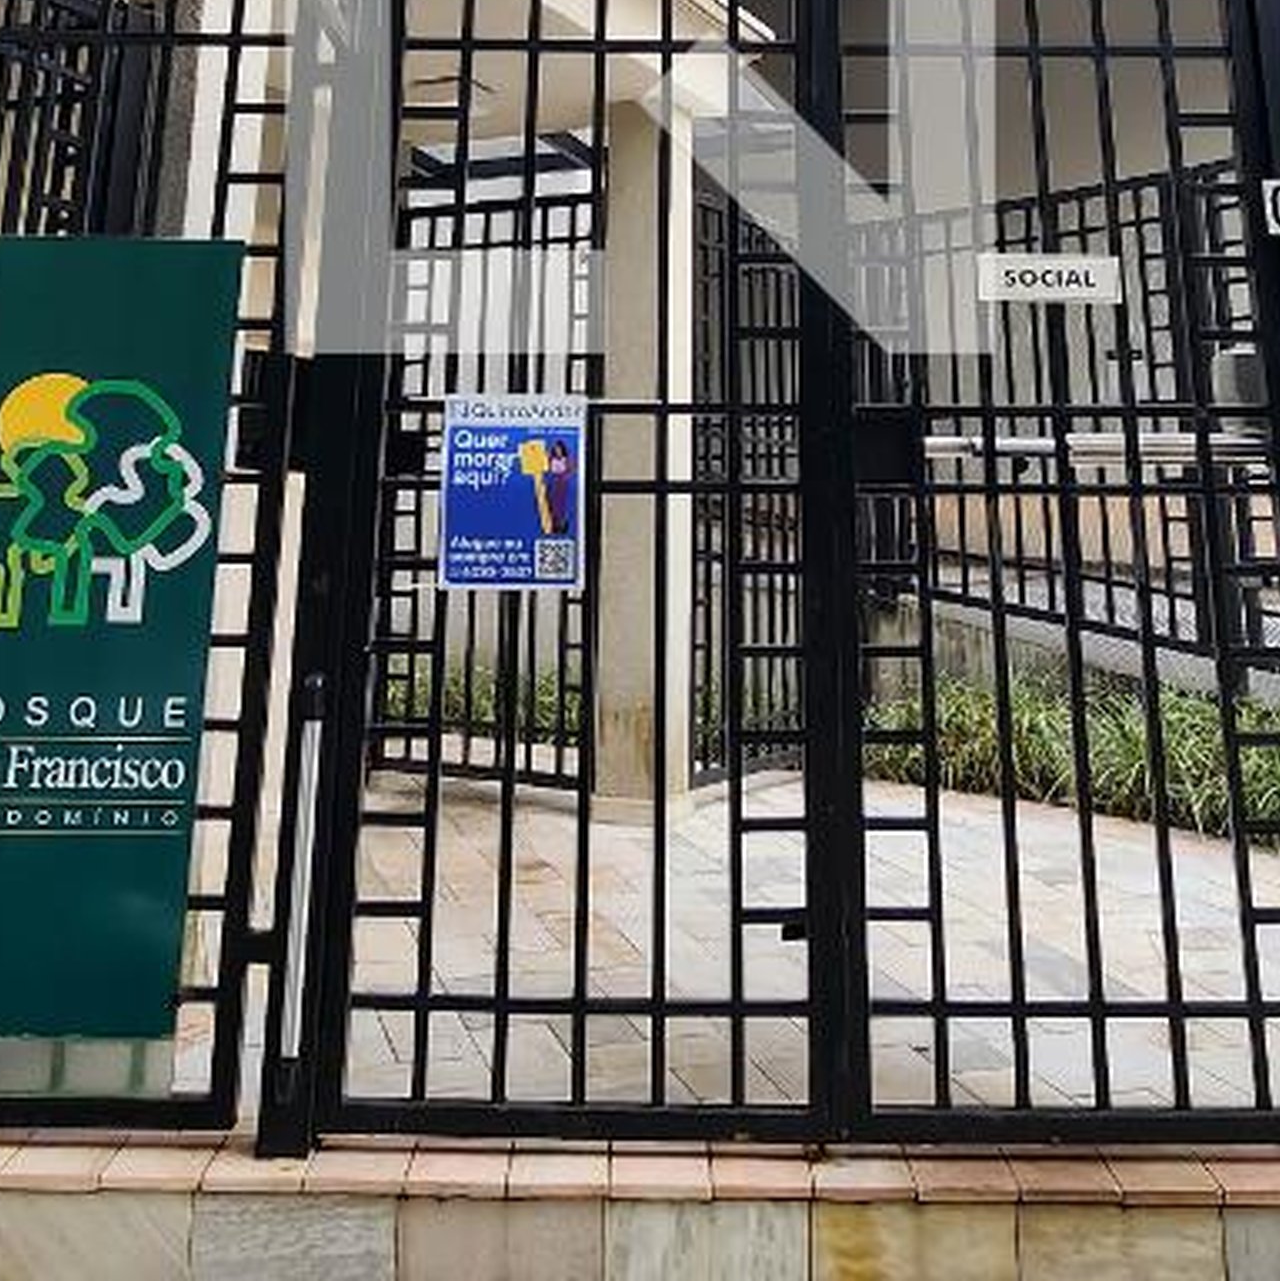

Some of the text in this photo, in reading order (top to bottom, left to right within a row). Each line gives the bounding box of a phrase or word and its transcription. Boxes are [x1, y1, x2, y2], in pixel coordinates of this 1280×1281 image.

[1004, 269, 1096, 288] SOCIAL
[454, 429, 509, 450] Quer
[454, 452, 516, 470] morar
[452, 468, 513, 491] aqui?
[2, 743, 186, 789] Francisco
